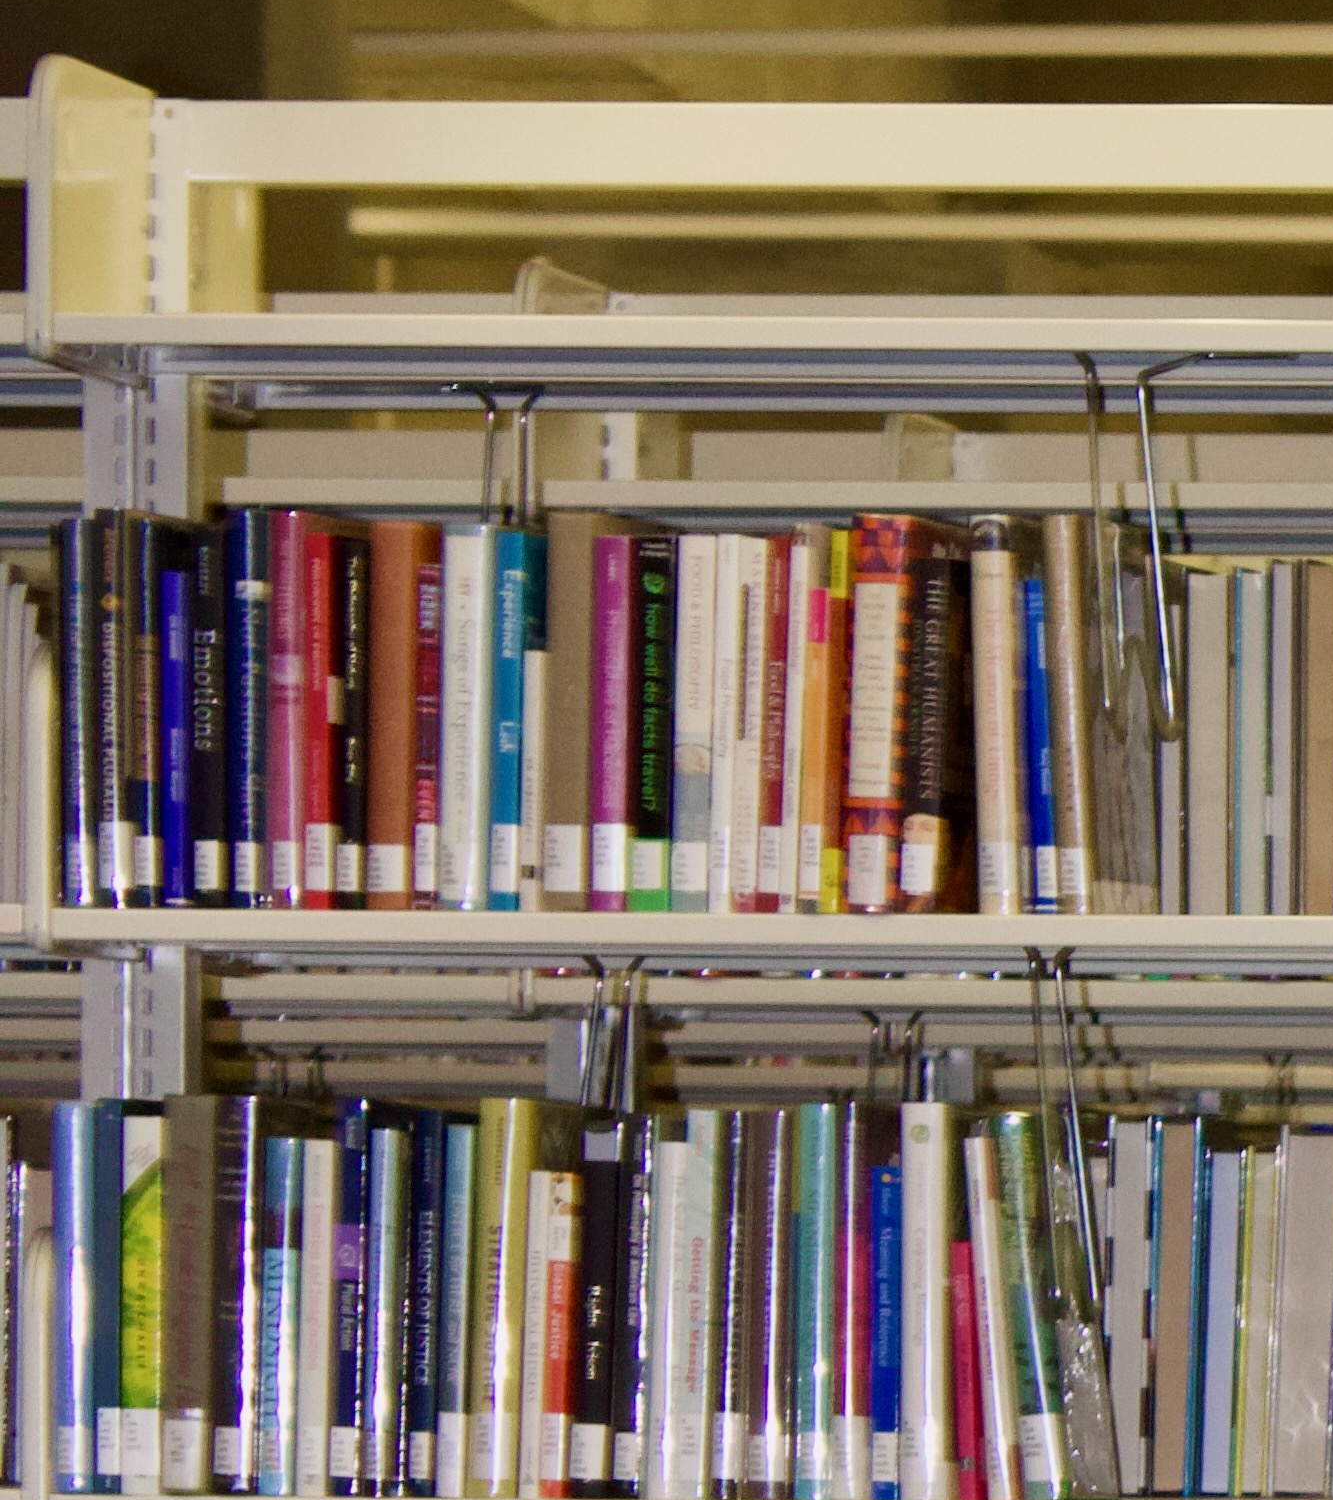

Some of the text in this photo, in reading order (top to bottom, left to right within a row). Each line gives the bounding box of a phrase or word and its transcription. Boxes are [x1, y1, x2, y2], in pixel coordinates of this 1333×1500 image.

[192, 628, 218, 751] Emotions
[452, 618, 475, 802] Songs of Experience
[499, 569, 520, 753] Experience Lash
[640, 603, 659, 811] how well do facts travel?
[688, 554, 703, 710] FOOD & PHILOSOPHY
[919, 579, 944, 800] THE GREAT HUMANISTS
[764, 661, 781, 780] Food & Philosophy
[338, 1283, 355, 1351] Plural Action
[414, 1209, 433, 1386] ELEMENTS OF JUSTICE
[549, 1262, 565, 1360] Global Justice
[685, 1236, 703, 1394] Getting the Message
[874, 1227, 892, 1368] Meaning and Reference
